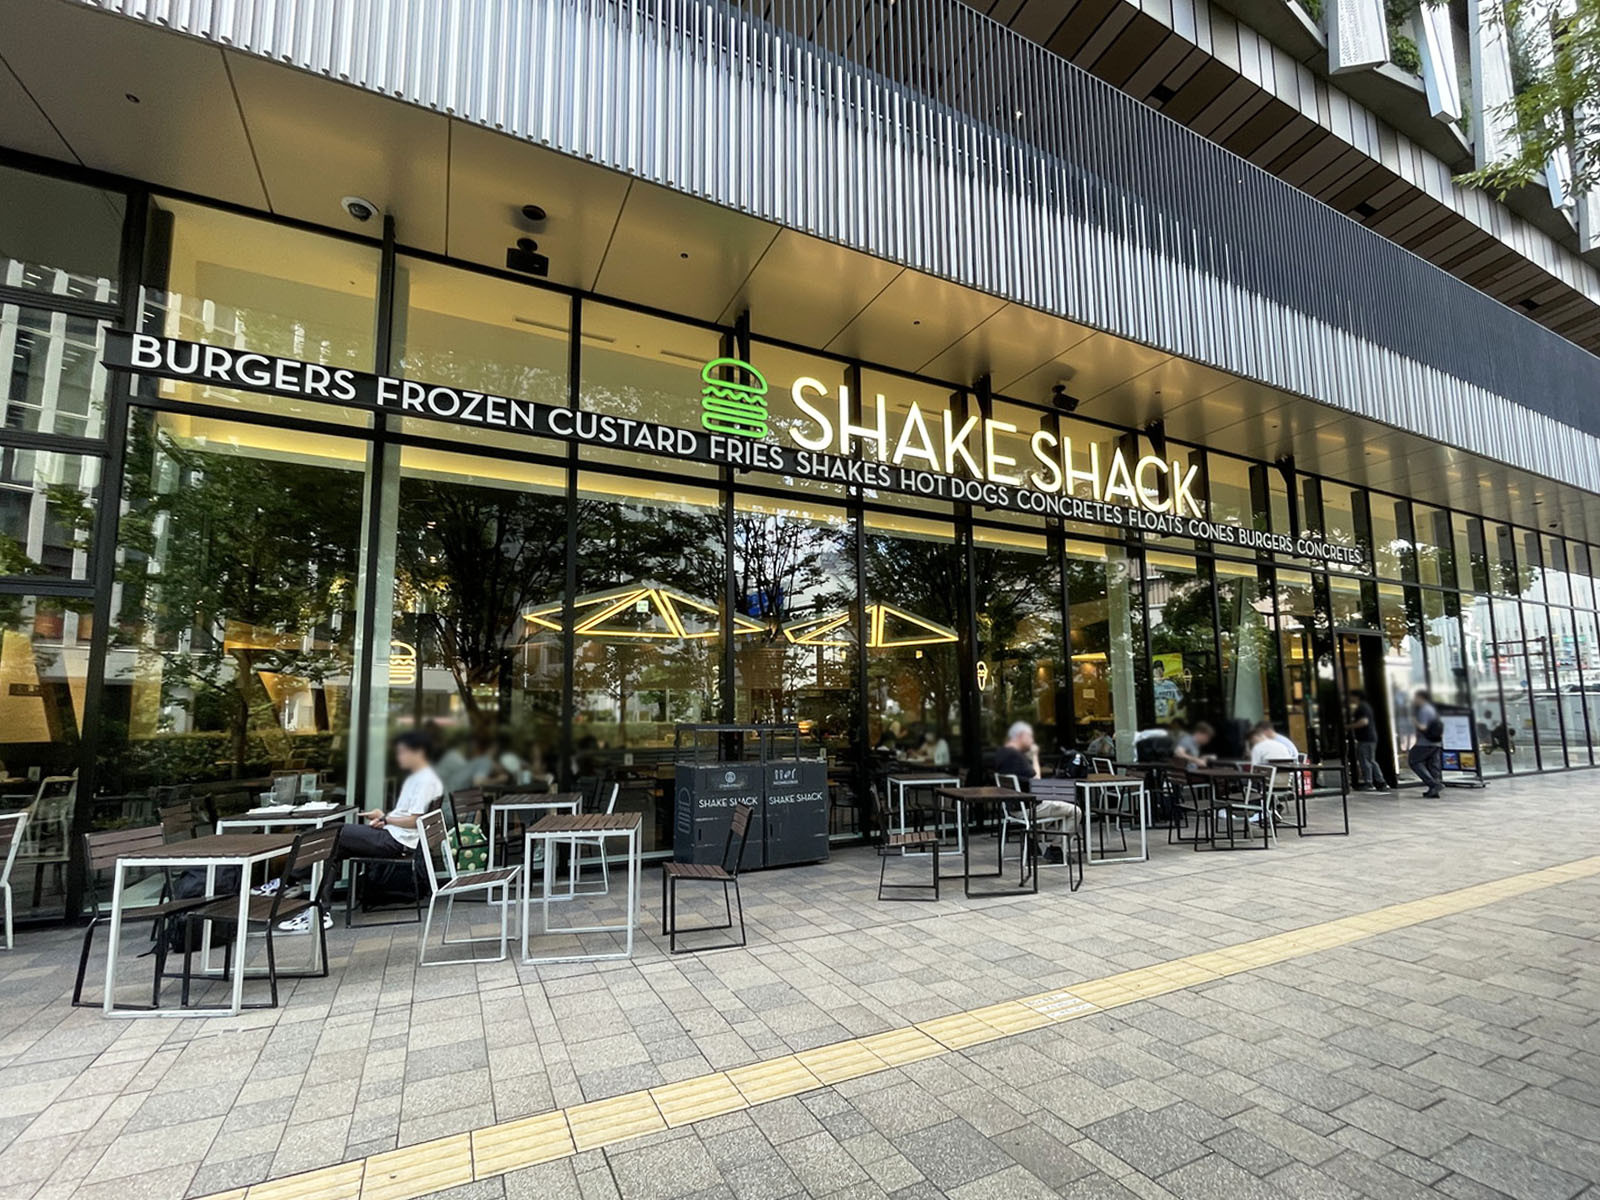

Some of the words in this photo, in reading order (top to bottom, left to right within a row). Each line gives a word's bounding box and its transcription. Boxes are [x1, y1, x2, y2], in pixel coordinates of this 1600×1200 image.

[130, 333, 357, 400] BURGERS
[376, 376, 535, 430] FROZEN
[548, 407, 697, 455] CUSTARD
[710, 435, 784, 470] FRIES
[796, 452, 892, 487] SHAKES
[900, 469, 947, 494] HOT
[951, 477, 1009, 506] DOGS
[1016, 489, 1123, 525] CONCRETES
[1128, 509, 1184, 534] FLOATS
[1188, 521, 1235, 543] CONES
[1238, 528, 1293, 553] BURGERS
[1296, 539, 1362, 564] CONCRETES
[789, 376, 1021, 486] SHAKE
[1029, 430, 1203, 519] SHACK
[698, 797, 728, 809] SHAKE
[769, 795, 795, 805] SHAKE
[796, 792, 823, 802] SHACK
